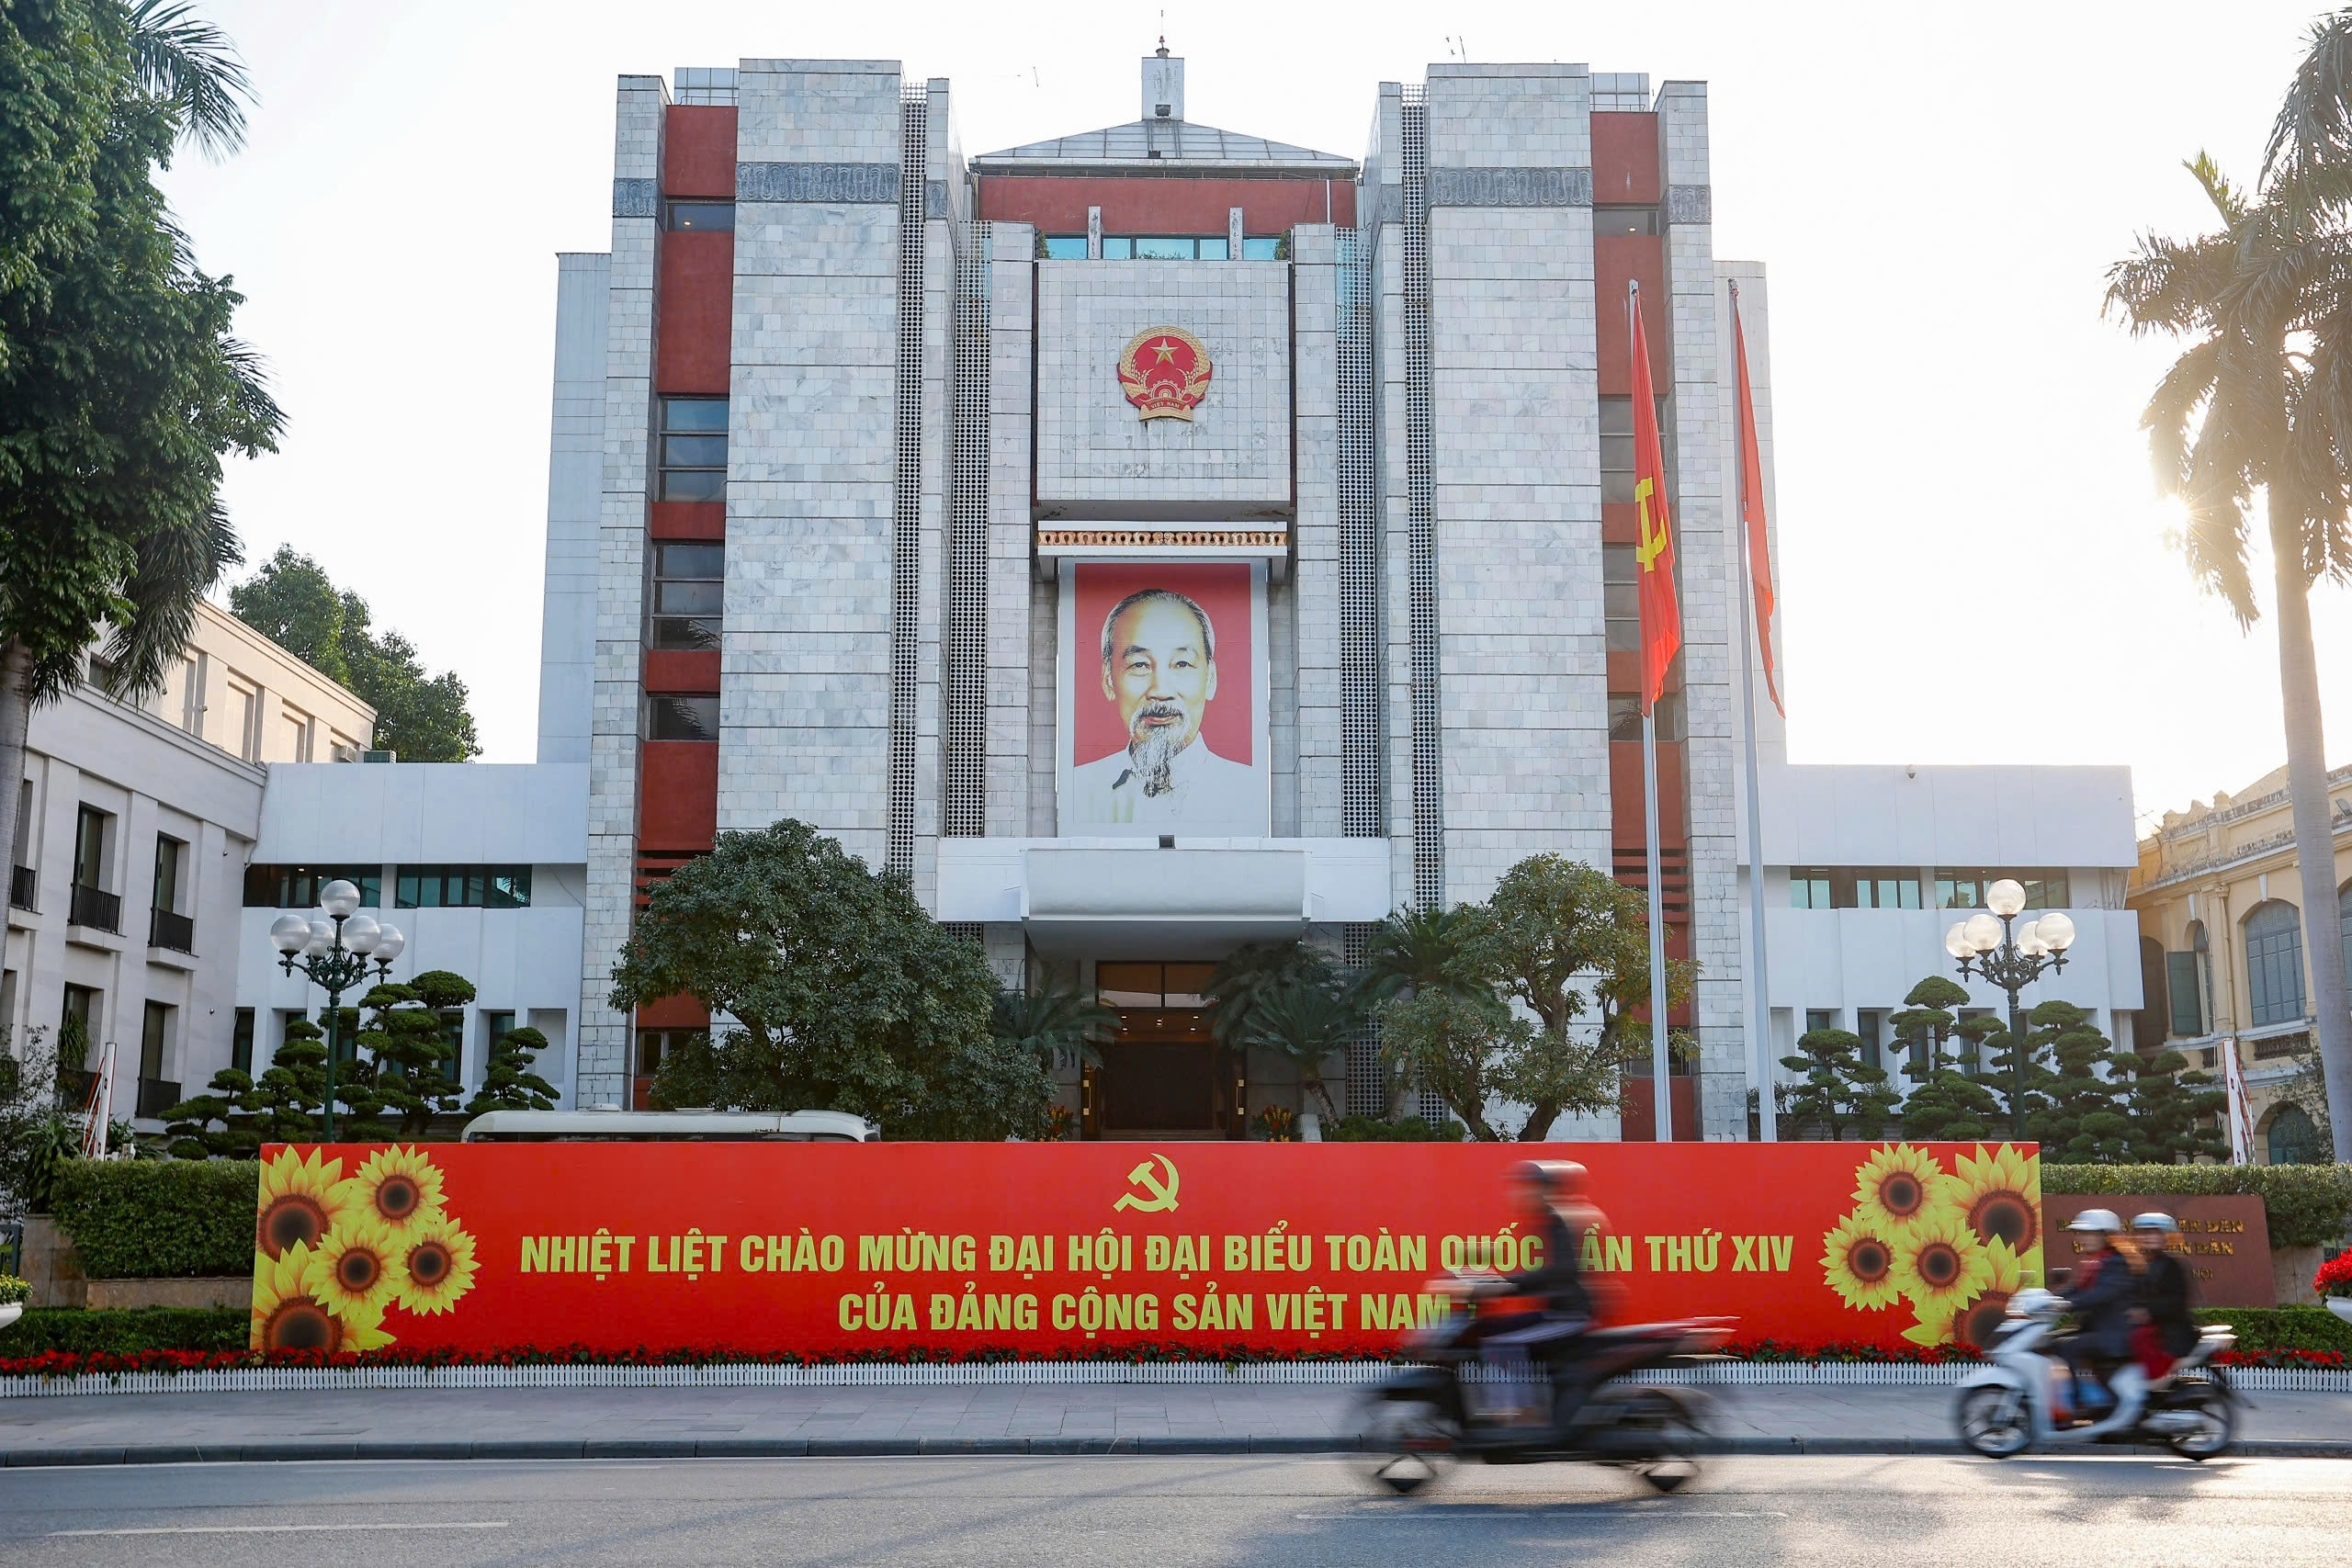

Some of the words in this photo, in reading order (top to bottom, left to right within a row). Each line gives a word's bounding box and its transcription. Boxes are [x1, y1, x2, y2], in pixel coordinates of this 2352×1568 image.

[521, 1227, 636, 1281] NHIỆT
[648, 1227, 728, 1280] LIỆT
[740, 1227, 844, 1272] CHÀO
[858, 1226, 977, 1272] MỪNG
[988, 1235, 1054, 1280] ĐẠI
[1068, 1226, 1132, 1280] HỘI
[1144, 1235, 1210, 1280] ĐẠI
[1224, 1219, 1312, 1272] BIỂU
[1324, 1226, 1427, 1272] TOÀN
[1440, 1222, 1544, 1276] QUỐC
[1577, 1222, 1633, 1272] ẦN
[1644, 1227, 1723, 1272] THỨ
[1731, 1235, 1794, 1272] XIV
[839, 1280, 918, 1331] CỦA
[929, 1280, 1038, 1331] ĐẢNG
[1052, 1285, 1159, 1338] CỘNG
[1172, 1280, 1253, 1331] SẢN
[1265, 1285, 1348, 1338] VIỆT
[1361, 1293, 1451, 1330] NAM
